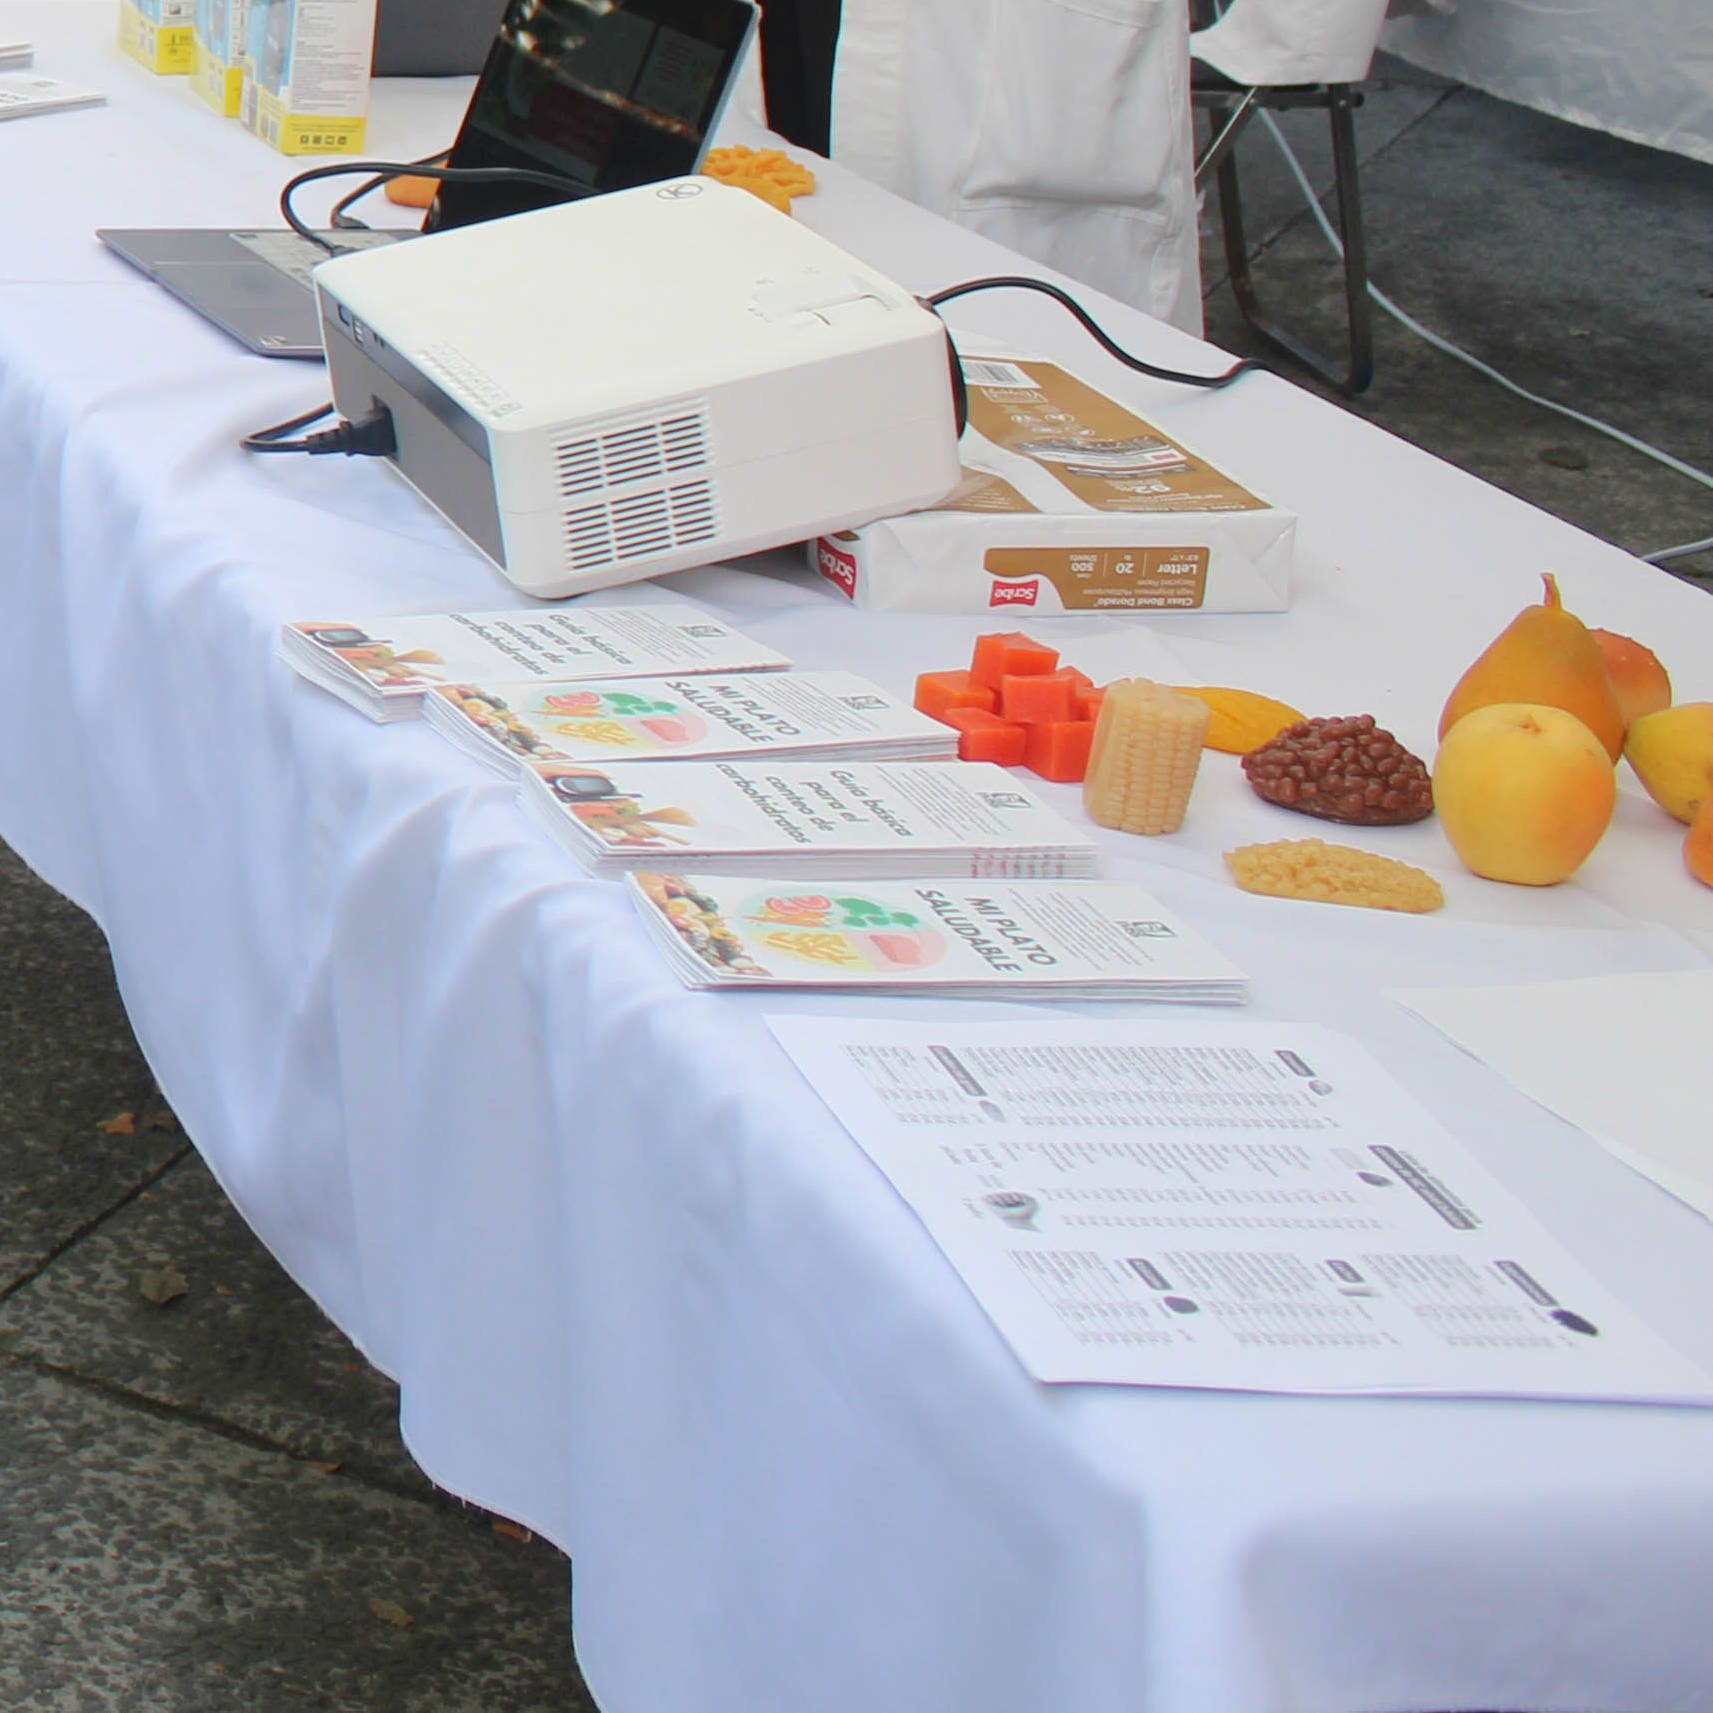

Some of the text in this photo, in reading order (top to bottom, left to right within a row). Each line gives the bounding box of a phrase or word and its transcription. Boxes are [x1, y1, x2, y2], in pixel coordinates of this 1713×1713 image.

[1071, 562, 1095, 573] 500
[1115, 562, 1135, 574] 20
[1157, 563, 1198, 575] Letter
[995, 587, 1035, 600] Scribe
[1138, 597, 1165, 607] Bond
[1167, 597, 1194, 607] Class
[665, 680, 776, 743] SALUDABLE
[709, 683, 739, 700] MI
[731, 698, 802, 737] PLATO
[715, 762, 814, 844] carbohidratos
[765, 775, 835, 832] conteo de
[798, 781, 870, 824] para el
[830, 769, 867, 798] Guía
[862, 795, 915, 837] básica
[914, 888, 1024, 974] SALUDABLE
[964, 896, 1005, 919] MI
[987, 918, 1058, 967] PLATO
